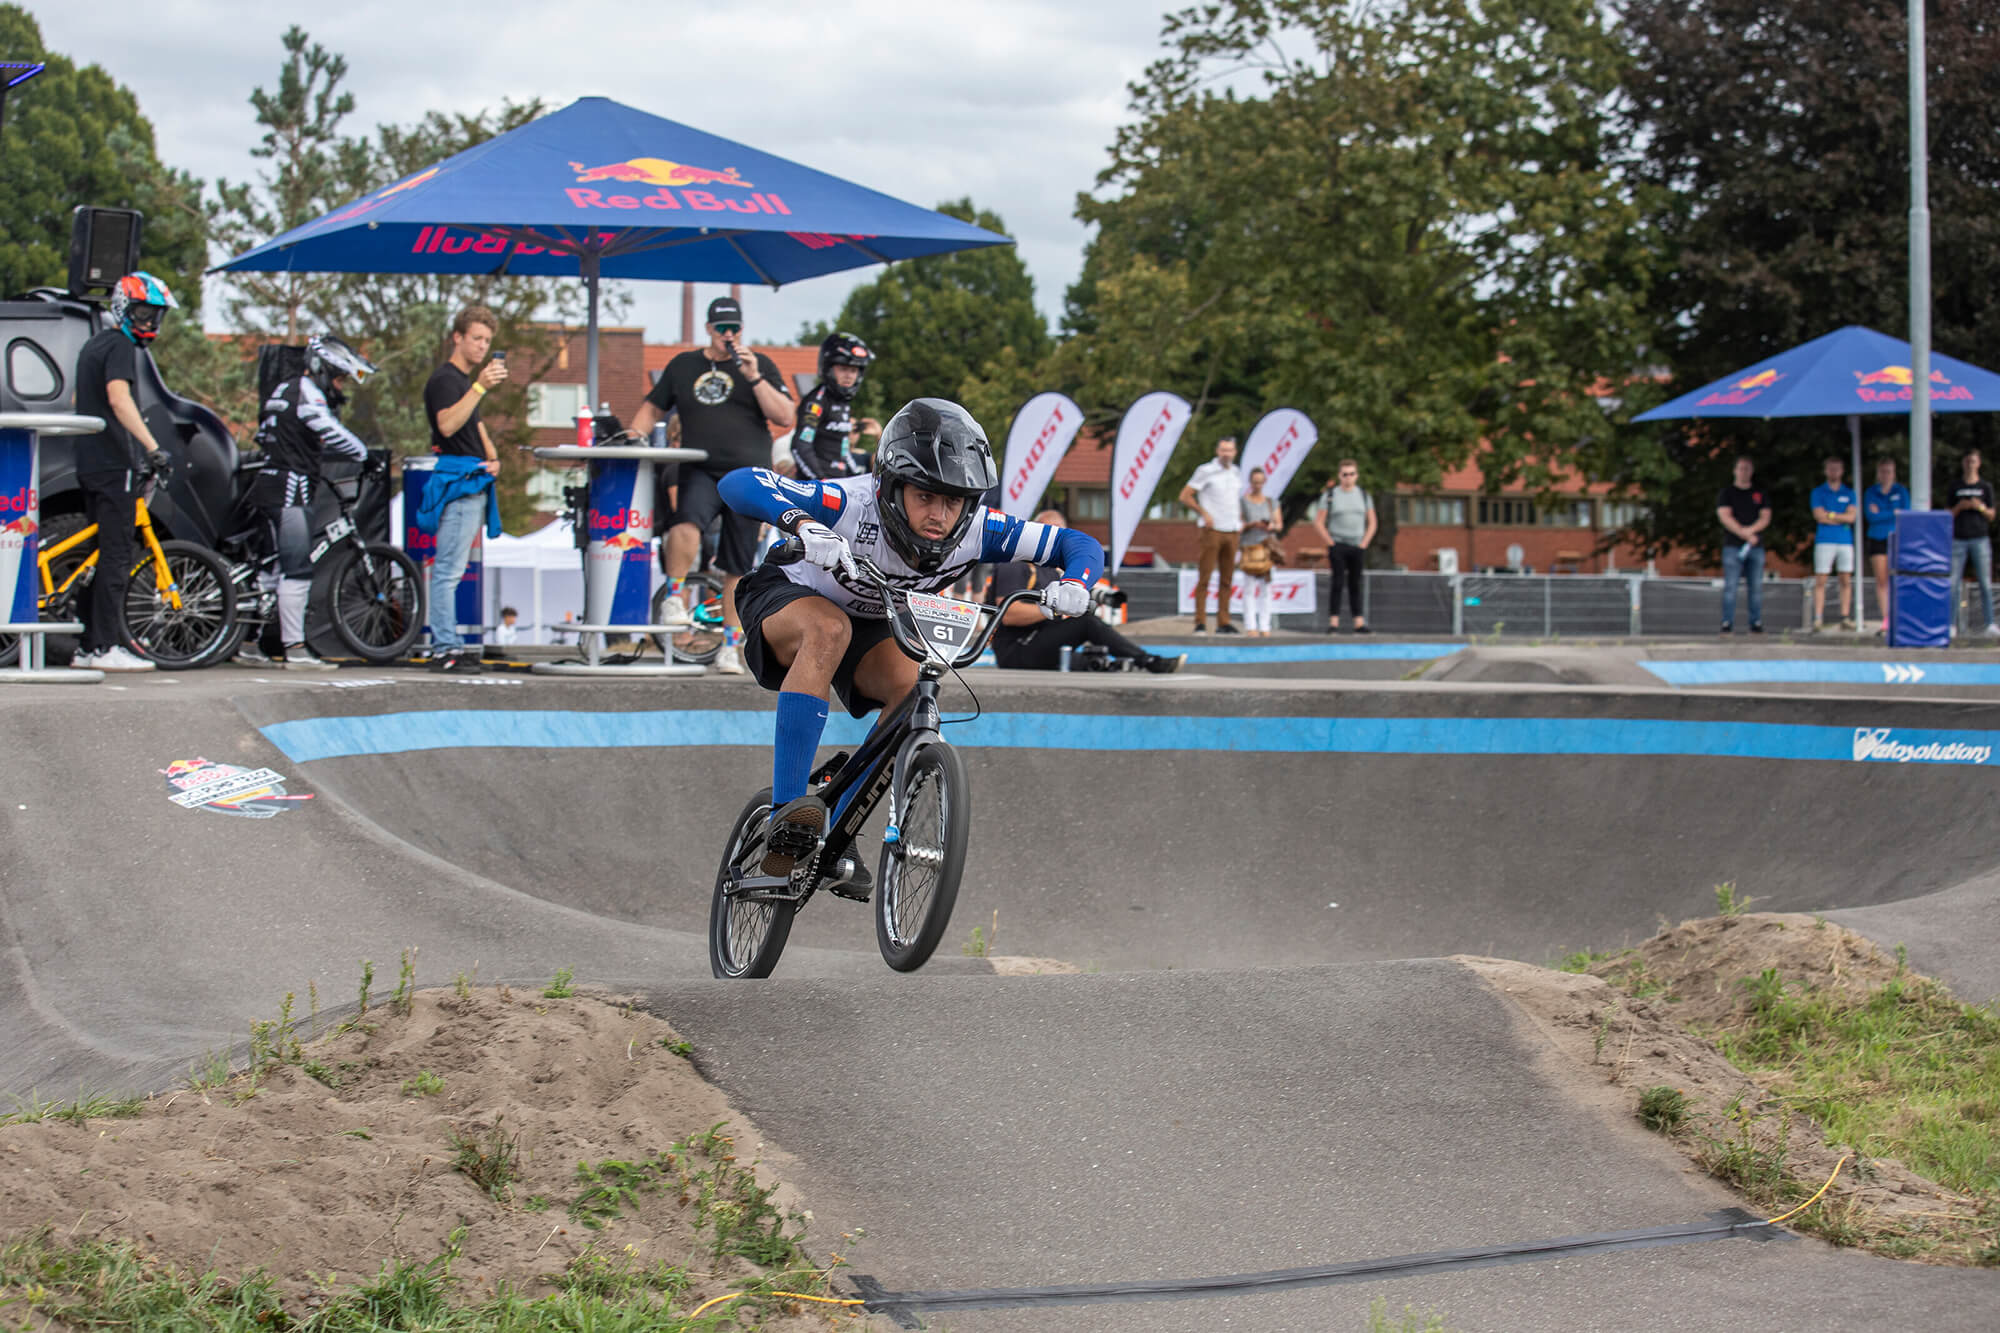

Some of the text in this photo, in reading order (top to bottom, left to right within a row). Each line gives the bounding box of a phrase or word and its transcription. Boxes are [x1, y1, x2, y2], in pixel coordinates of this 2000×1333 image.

[564, 187, 792, 216] Red Bull
[1008, 401, 1066, 501] GHOST
[1119, 400, 1174, 500] GHOST
[589, 508, 625, 530] Red
[911, 596, 947, 611] Red Bull
[932, 624, 954, 641] 61
